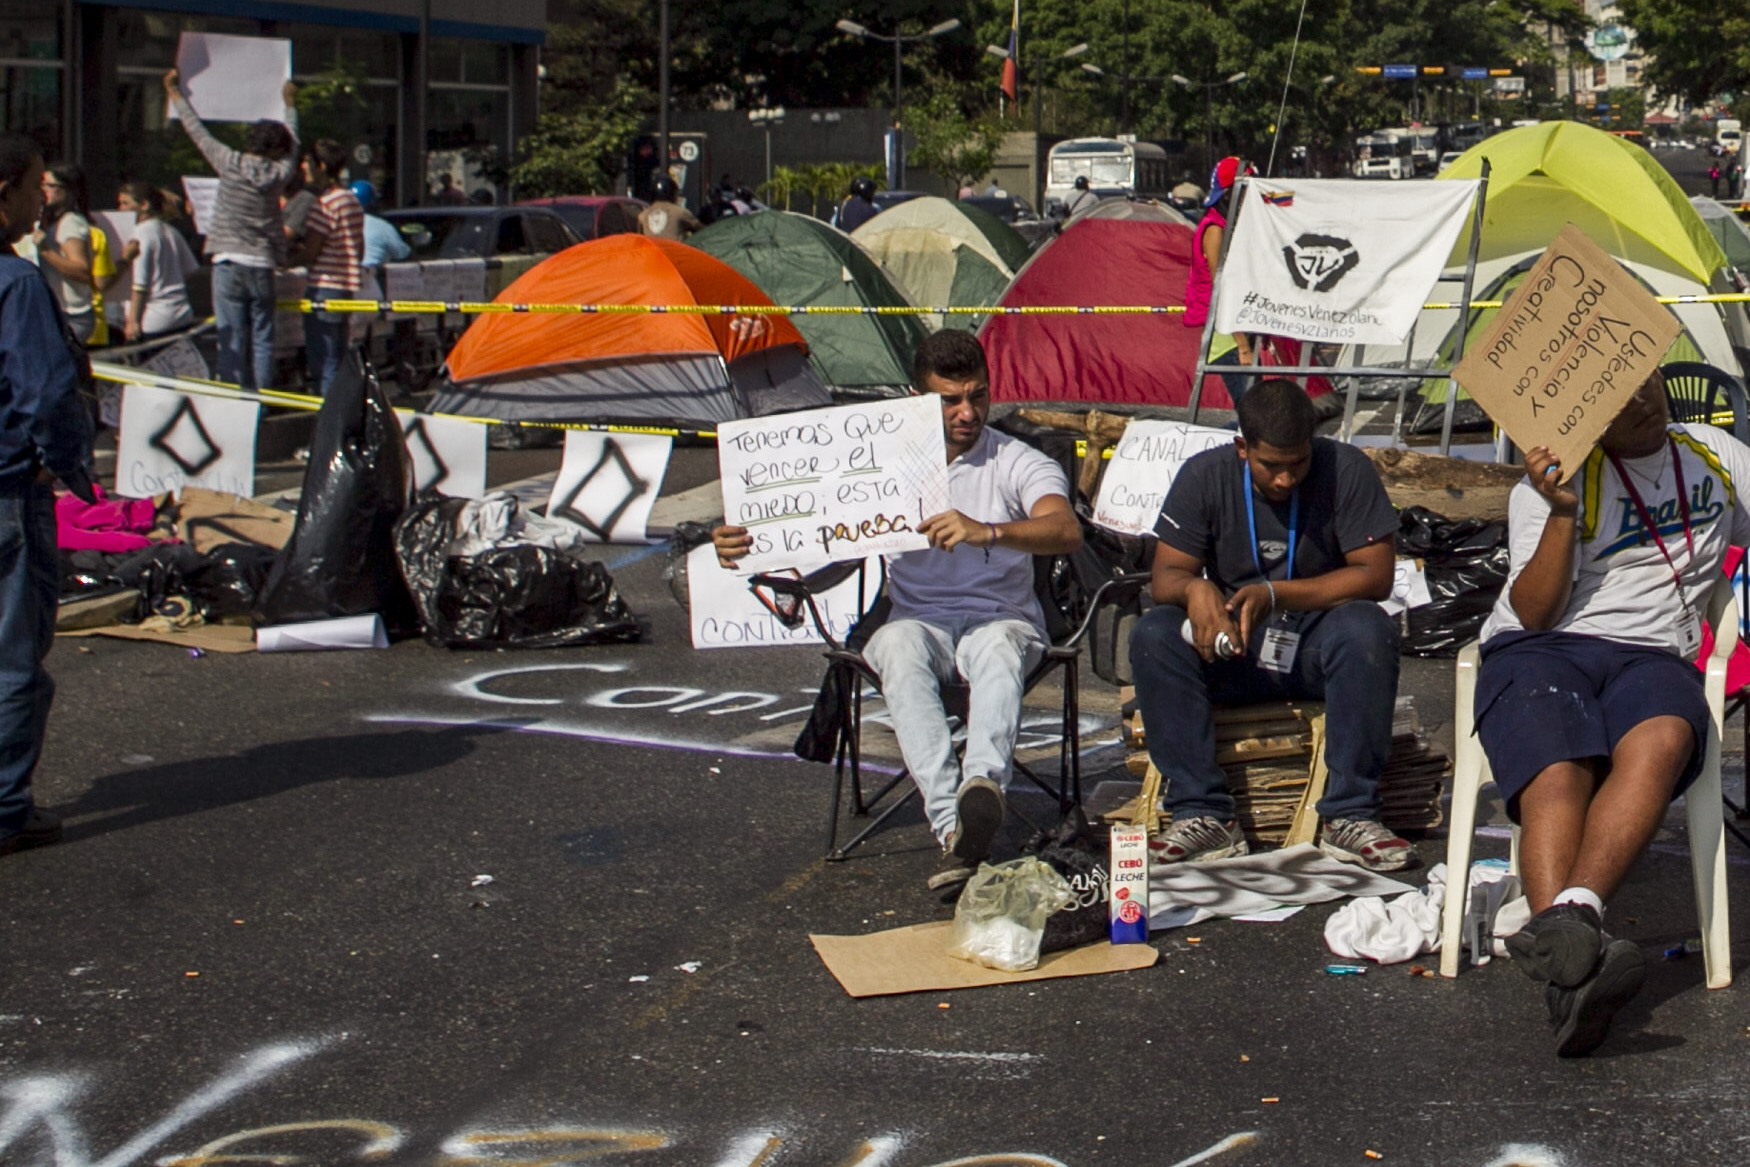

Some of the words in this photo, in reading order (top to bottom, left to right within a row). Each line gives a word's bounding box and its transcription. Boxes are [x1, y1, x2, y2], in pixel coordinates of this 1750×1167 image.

[1539, 278, 1607, 363] nosotros
[1543, 315, 1631, 399] Violencia
[1582, 329, 1657, 405] Ustedes
[1513, 364, 1539, 396] con
[1558, 405, 1585, 435] con
[848, 442, 881, 470] el
[1119, 435, 1189, 463] CANAL
[782, 528, 804, 552] la
[1115, 872, 1145, 882] LECHE
